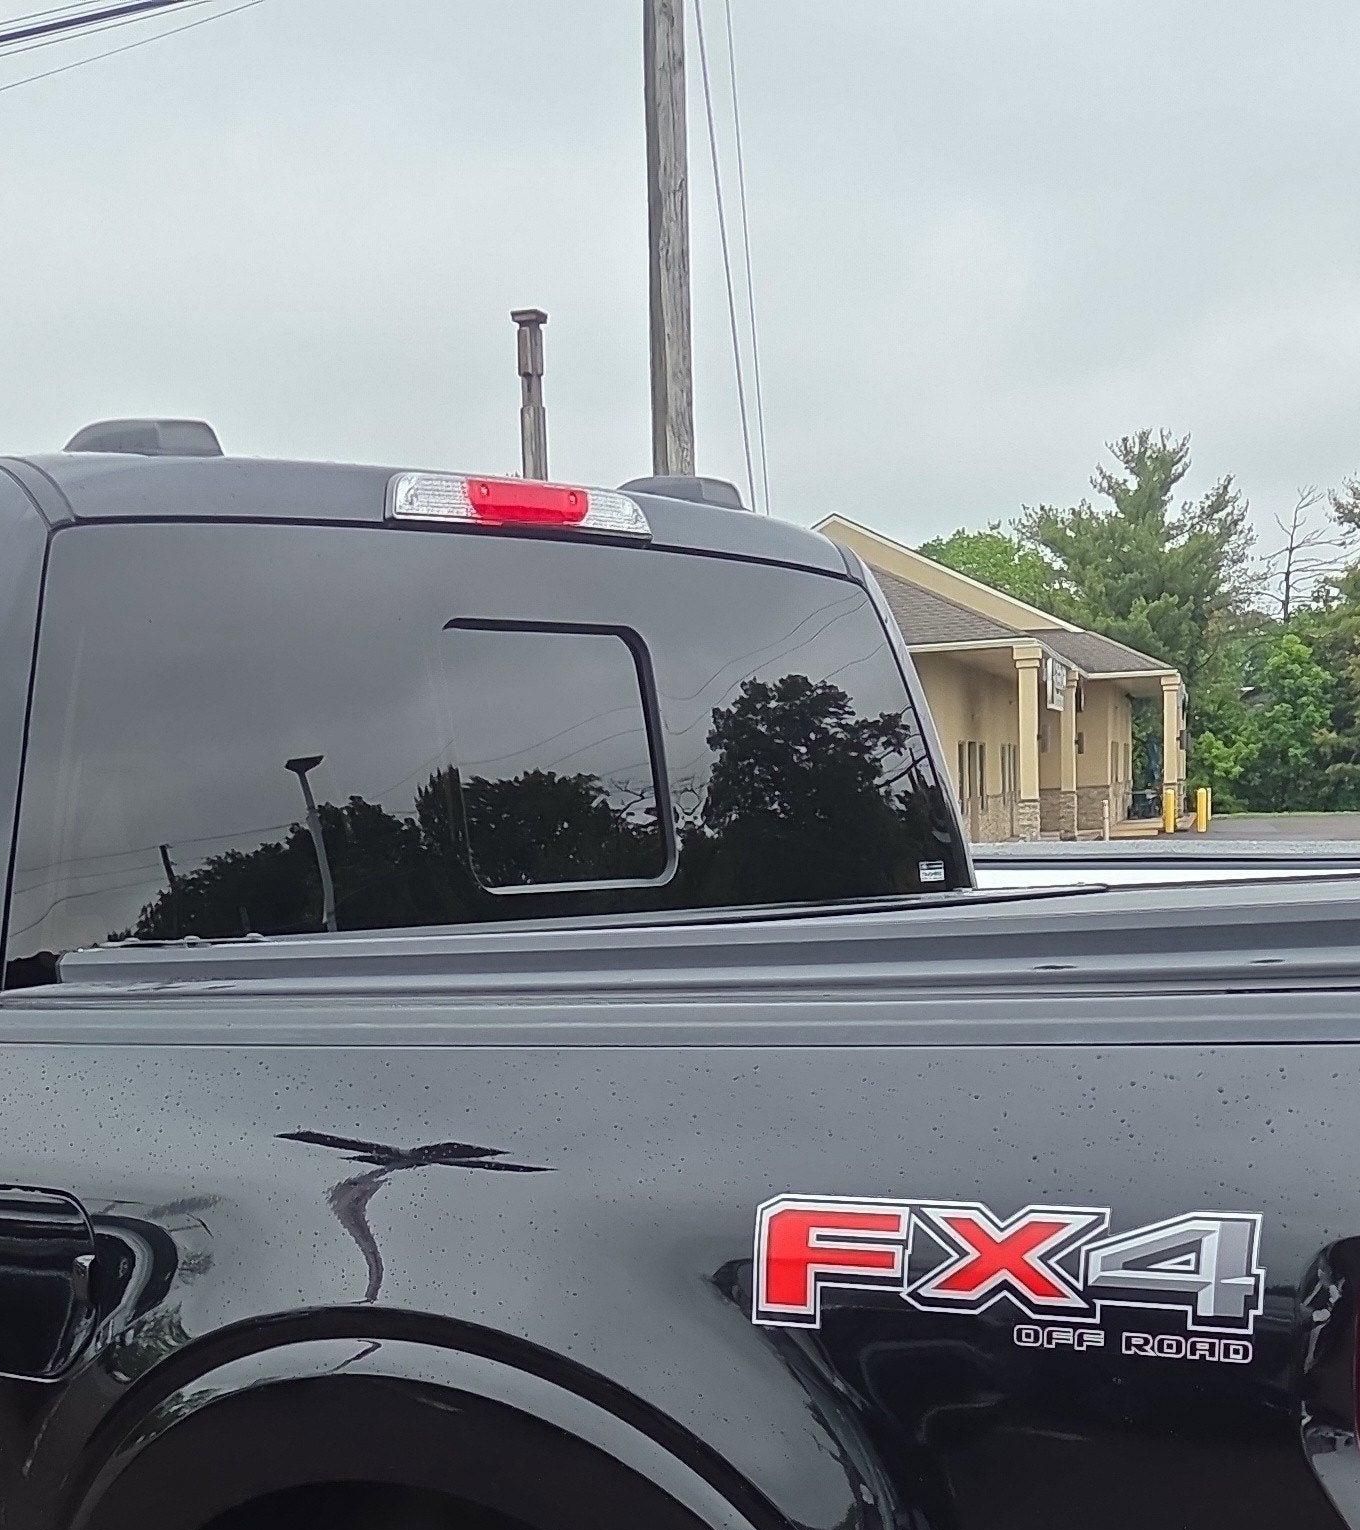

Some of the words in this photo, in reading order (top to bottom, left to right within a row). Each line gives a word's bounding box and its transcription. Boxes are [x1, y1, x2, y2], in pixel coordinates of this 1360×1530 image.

[752, 1194, 1266, 1334] FX4
[1012, 1324, 1105, 1352] OFF
[1121, 1332, 1254, 1364] ROAD
